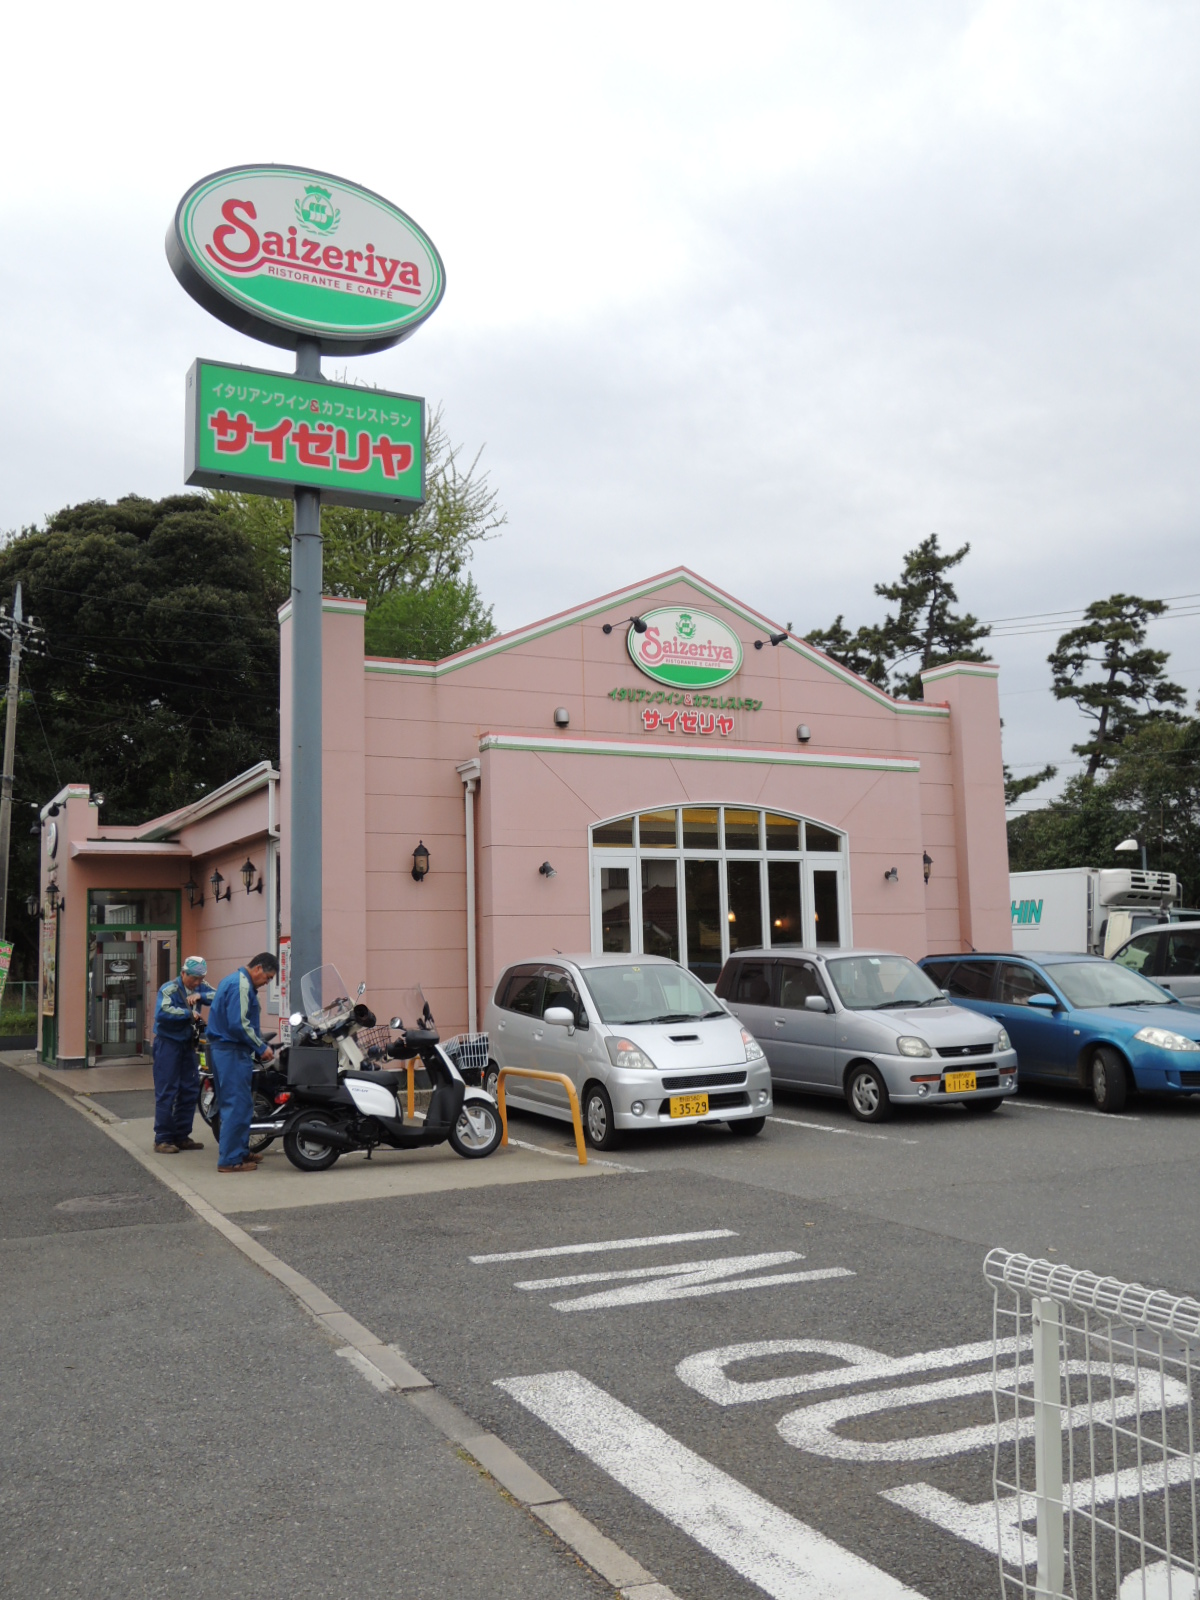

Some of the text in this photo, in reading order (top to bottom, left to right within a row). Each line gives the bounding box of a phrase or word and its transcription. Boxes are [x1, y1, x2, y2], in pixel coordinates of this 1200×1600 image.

[206, 198, 421, 294] Saizeriya
[267, 266, 341, 289] RISTORANTE
[346, 282, 353, 291] E
[212, 382, 412, 427] イタリアンワイン&カフェレストラン
[208, 407, 414, 480] サイゼリヤ
[639, 627, 734, 664] Saizeriya
[641, 708, 734, 736] サイゼリヤ
